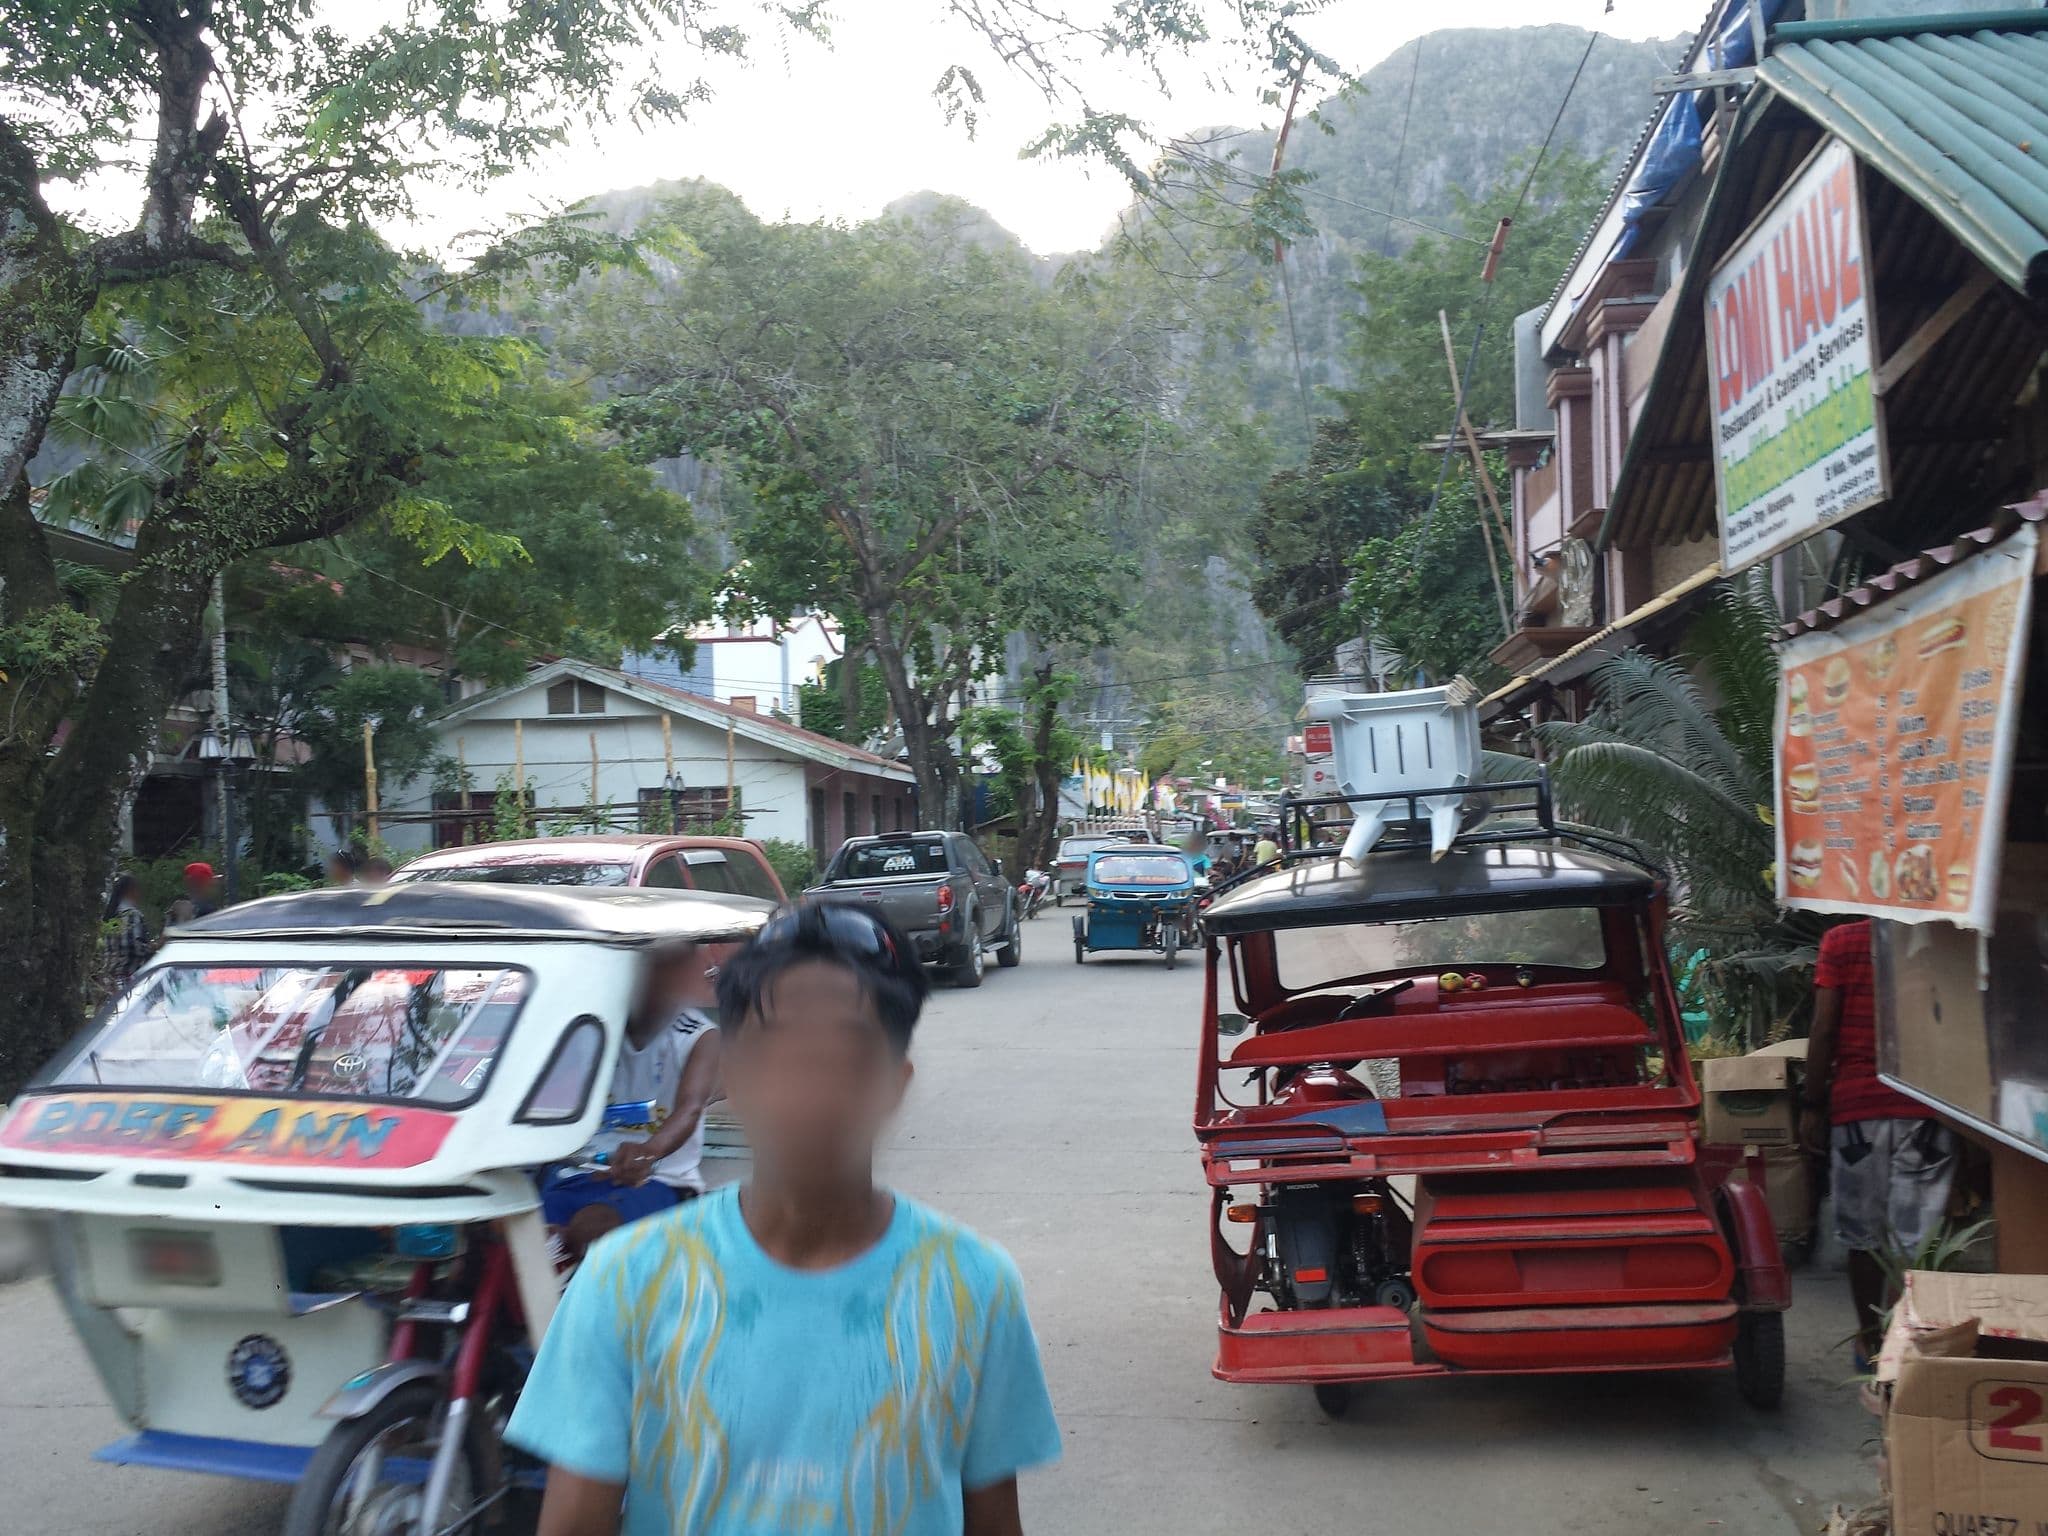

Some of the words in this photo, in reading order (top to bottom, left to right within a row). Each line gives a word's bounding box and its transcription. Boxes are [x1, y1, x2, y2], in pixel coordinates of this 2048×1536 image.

[1711, 250, 1774, 414] LOMI
[1773, 162, 1862, 361] HAUZ
[1721, 398, 1765, 442] Restaurant
[1767, 386, 1774, 408] &
[1776, 356, 1815, 401] Catering
[1818, 317, 1863, 368] Services
[222, 1107, 401, 1159] ANN
[1989, 1386, 2043, 1452] 2
